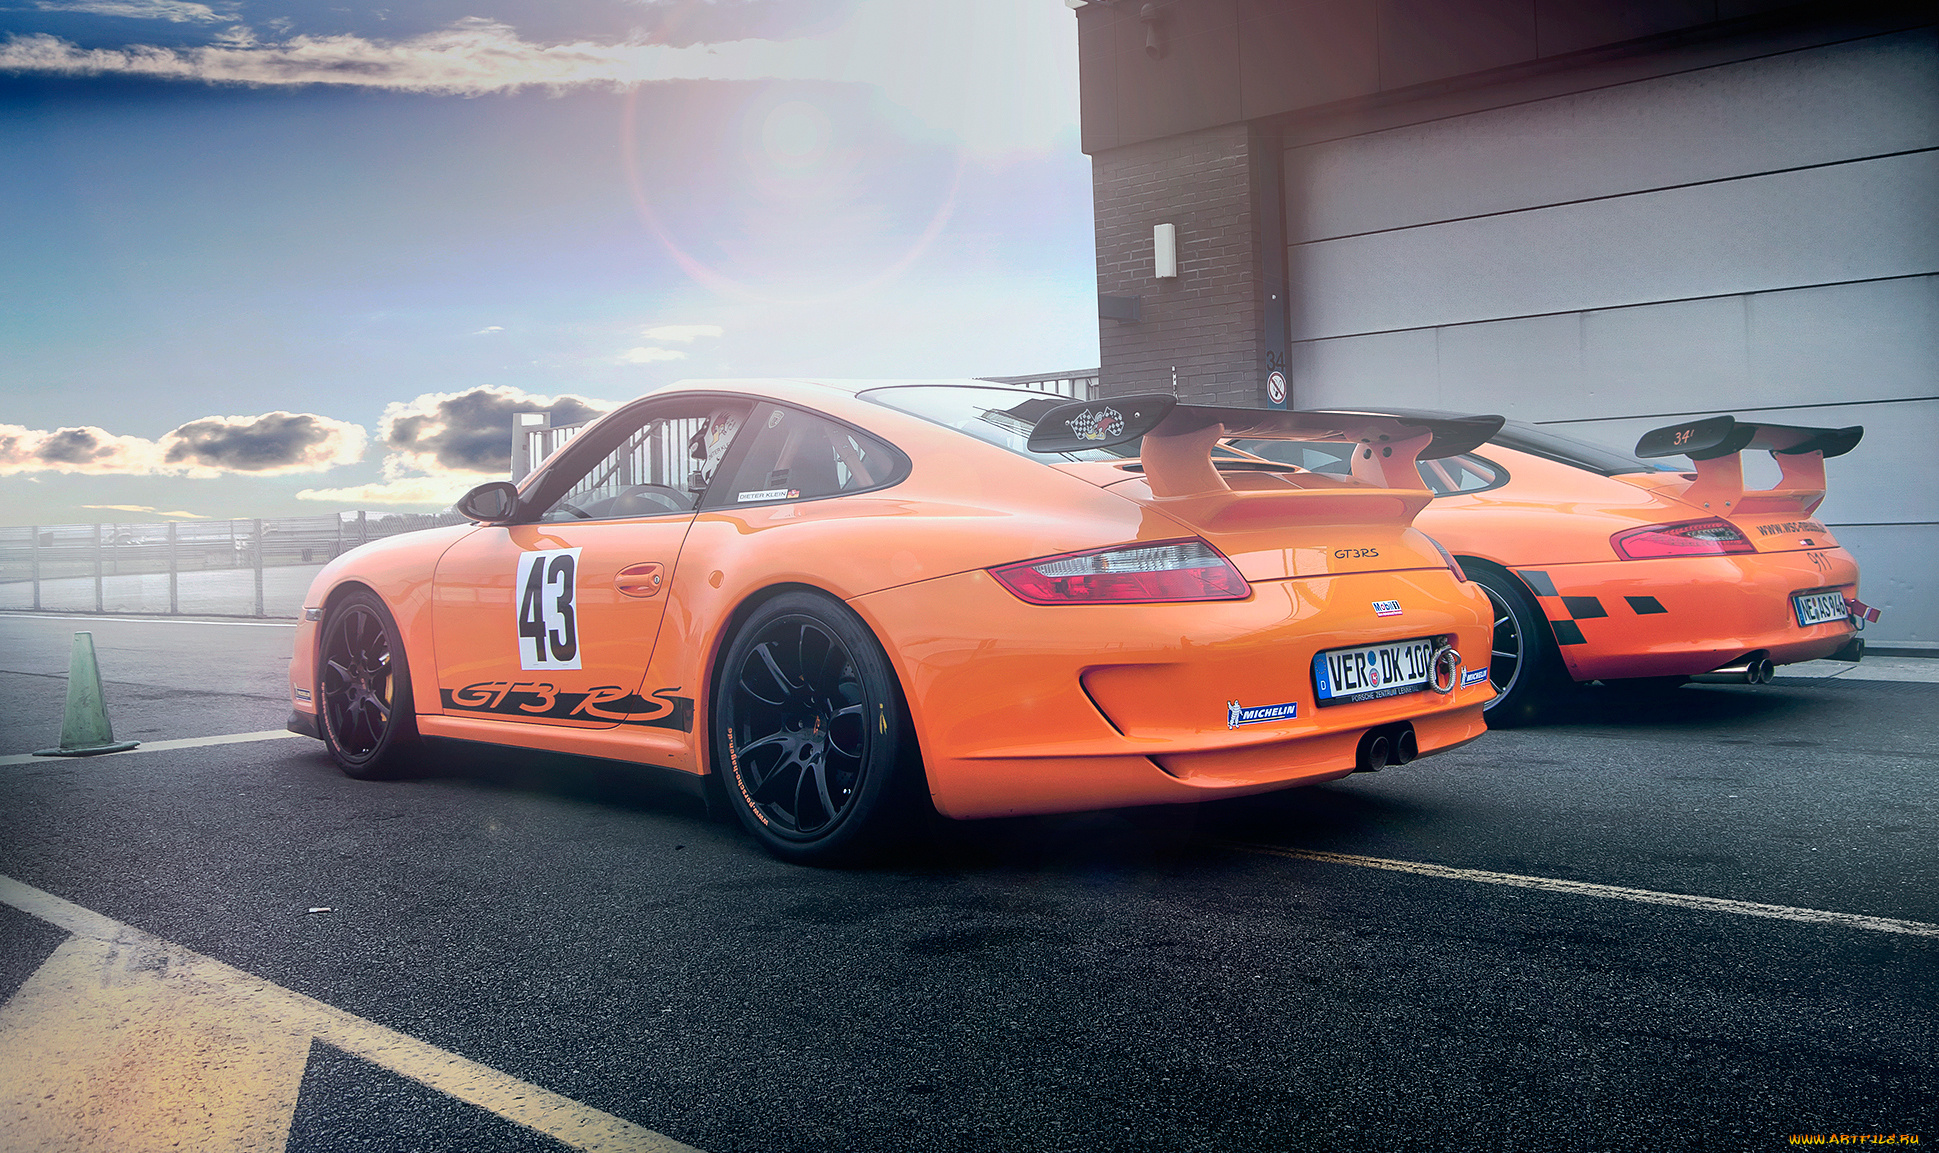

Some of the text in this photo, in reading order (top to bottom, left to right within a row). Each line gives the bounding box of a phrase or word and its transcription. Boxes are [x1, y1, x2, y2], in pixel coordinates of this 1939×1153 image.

[1266, 350, 1286, 372] 34
[740, 492, 765, 500] DIETER
[1806, 552, 1832, 572] 911
[519, 554, 577, 662] 43
[1800, 598, 1816, 621] NE
[1817, 596, 1831, 618] AS
[1328, 652, 1369, 692] VER
[1380, 647, 1405, 684] DK
[1320, 680, 1327, 691] D
[1351, 691, 1375, 702] PORSCHE
[1375, 689, 1398, 699] ZENTRUM
[452, 681, 682, 721] GT3 RS
[1242, 705, 1296, 720] MICHELIN
